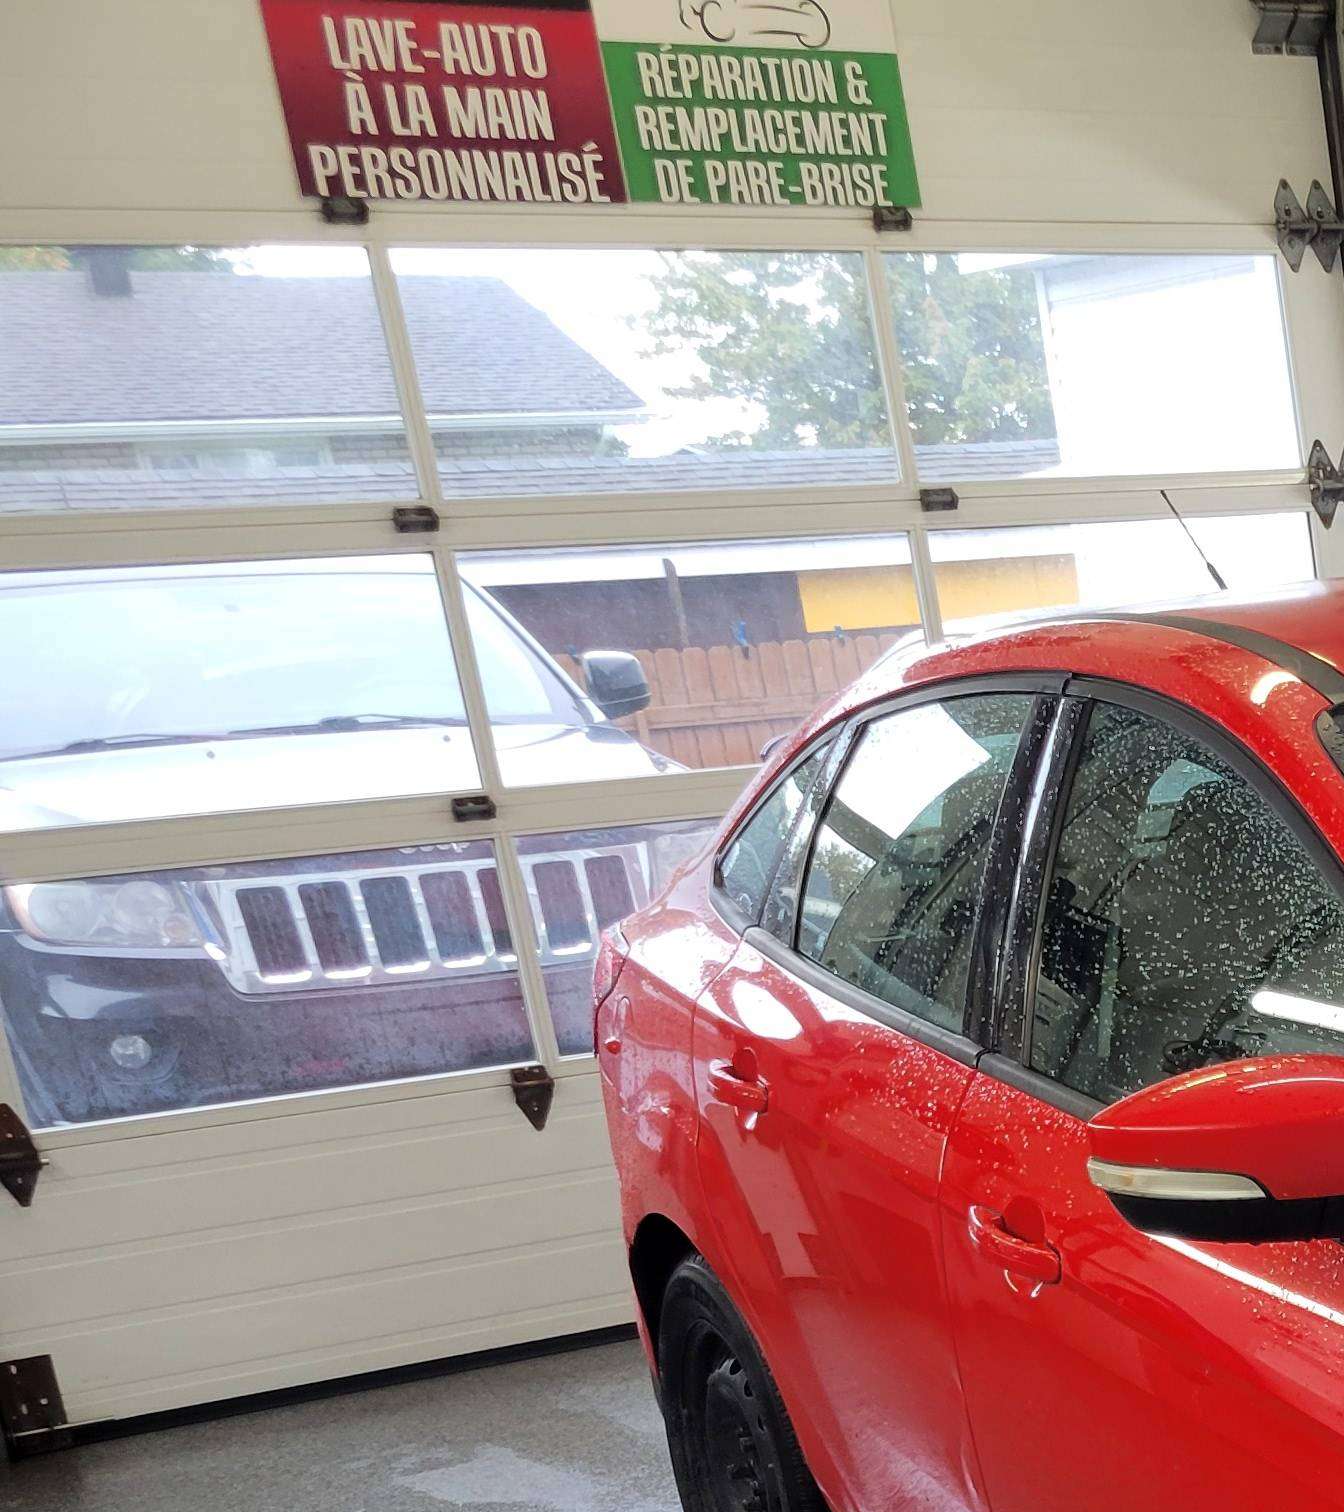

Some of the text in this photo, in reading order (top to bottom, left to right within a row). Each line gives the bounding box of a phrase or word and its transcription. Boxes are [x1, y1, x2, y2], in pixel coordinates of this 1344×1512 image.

[322, 16, 547, 79] LAVE-AUTO
[636, 43, 872, 104] RÉPARATION &
[344, 72, 554, 141] À LA MAIN
[635, 104, 888, 157] REMPLACEMENT
[308, 141, 612, 202] PERSONNALISÉ
[654, 158, 893, 207] DE PARE-BRISE
